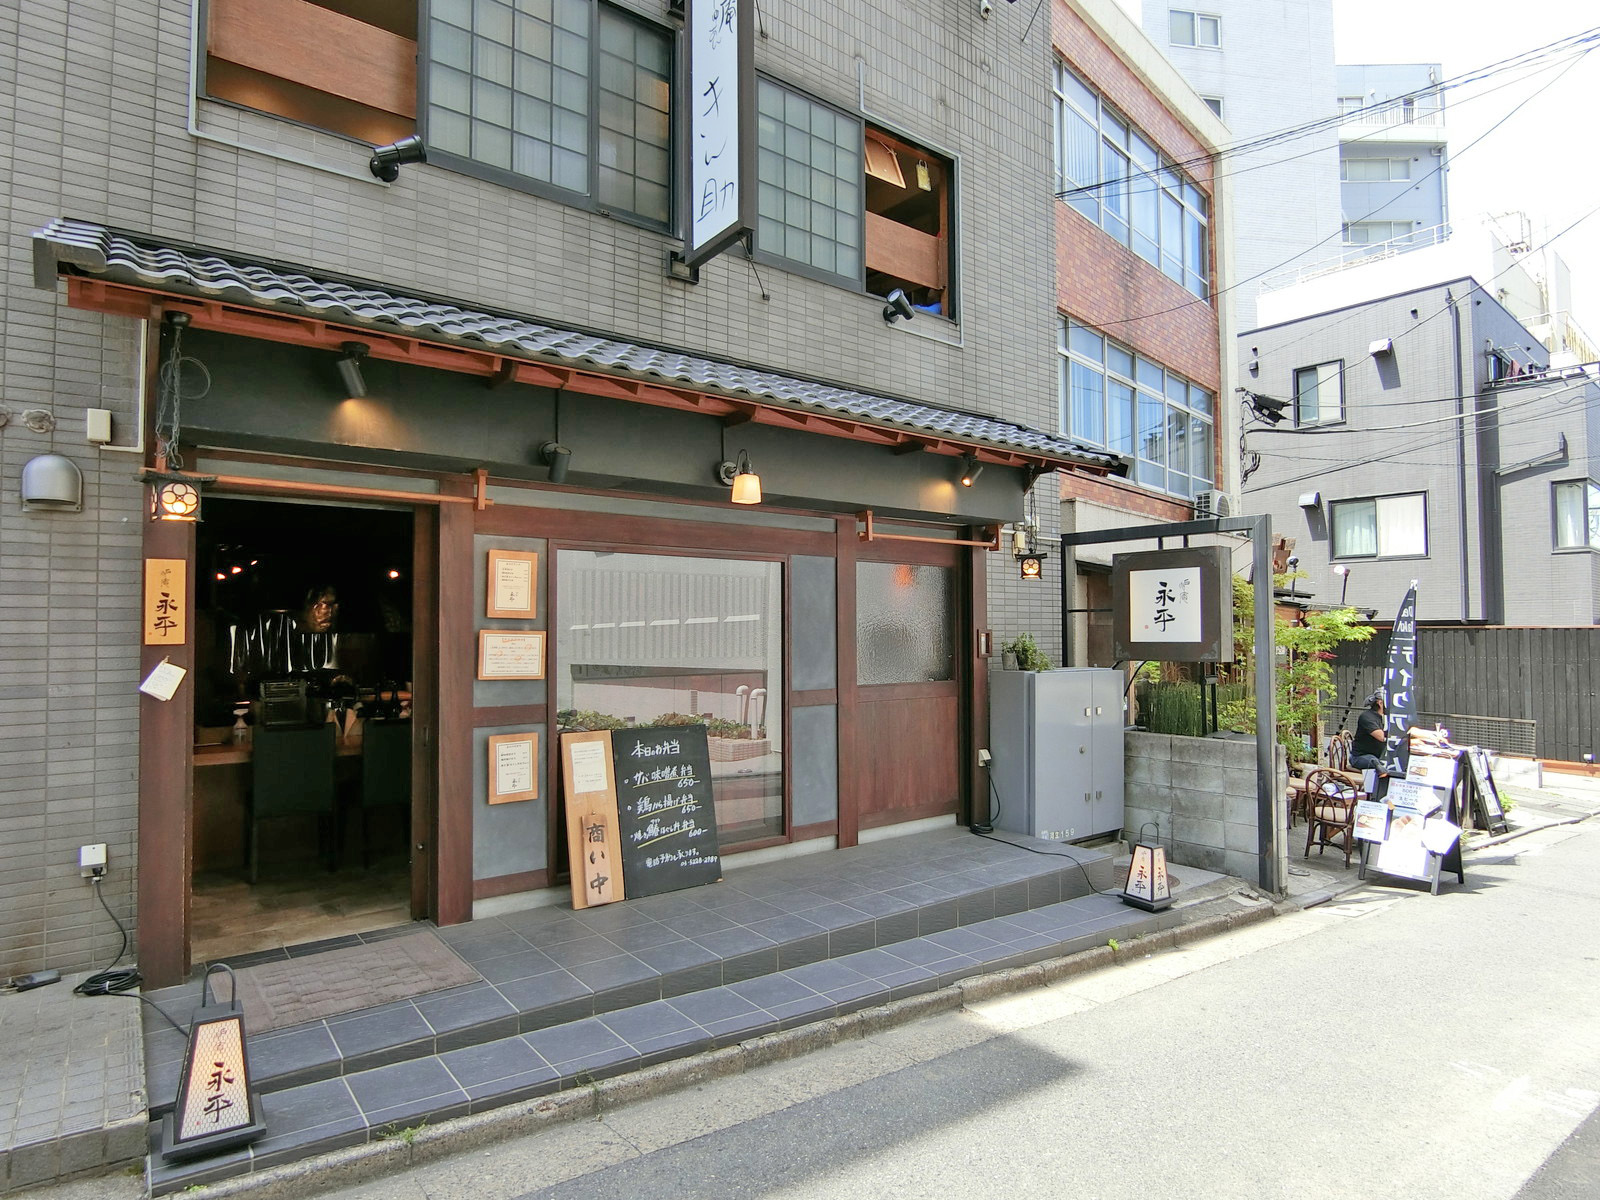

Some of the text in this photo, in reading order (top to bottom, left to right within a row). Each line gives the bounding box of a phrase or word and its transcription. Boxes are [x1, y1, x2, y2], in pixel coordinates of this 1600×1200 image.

[153, 592, 179, 637] 永平
[1153, 581, 1176, 632] 永平
[631, 739, 681, 757] 本日のお弁当
[586, 823, 609, 895] 商い中
[1135, 865, 1147, 894] 永平
[203, 1061, 235, 1124] 永平
